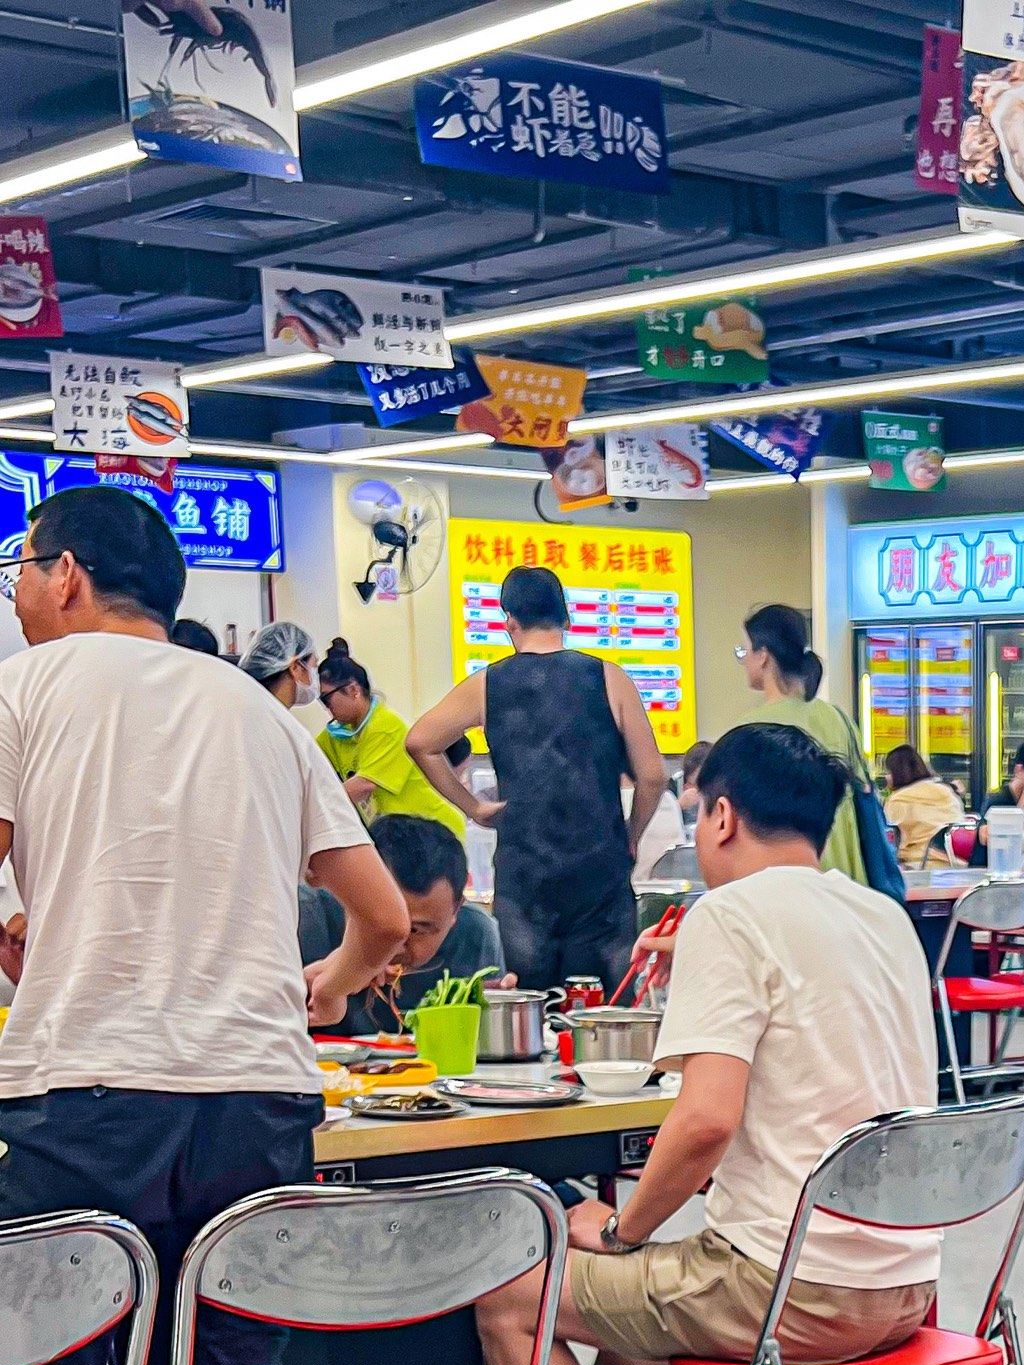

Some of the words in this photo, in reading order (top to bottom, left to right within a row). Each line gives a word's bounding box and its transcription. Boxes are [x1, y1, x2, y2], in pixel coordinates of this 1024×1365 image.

[507, 82, 596, 130] 不能
[133, 489, 252, 542] 鱼铺
[464, 533, 569, 570] 饮料自取
[580, 541, 678, 575] 餐后结账
